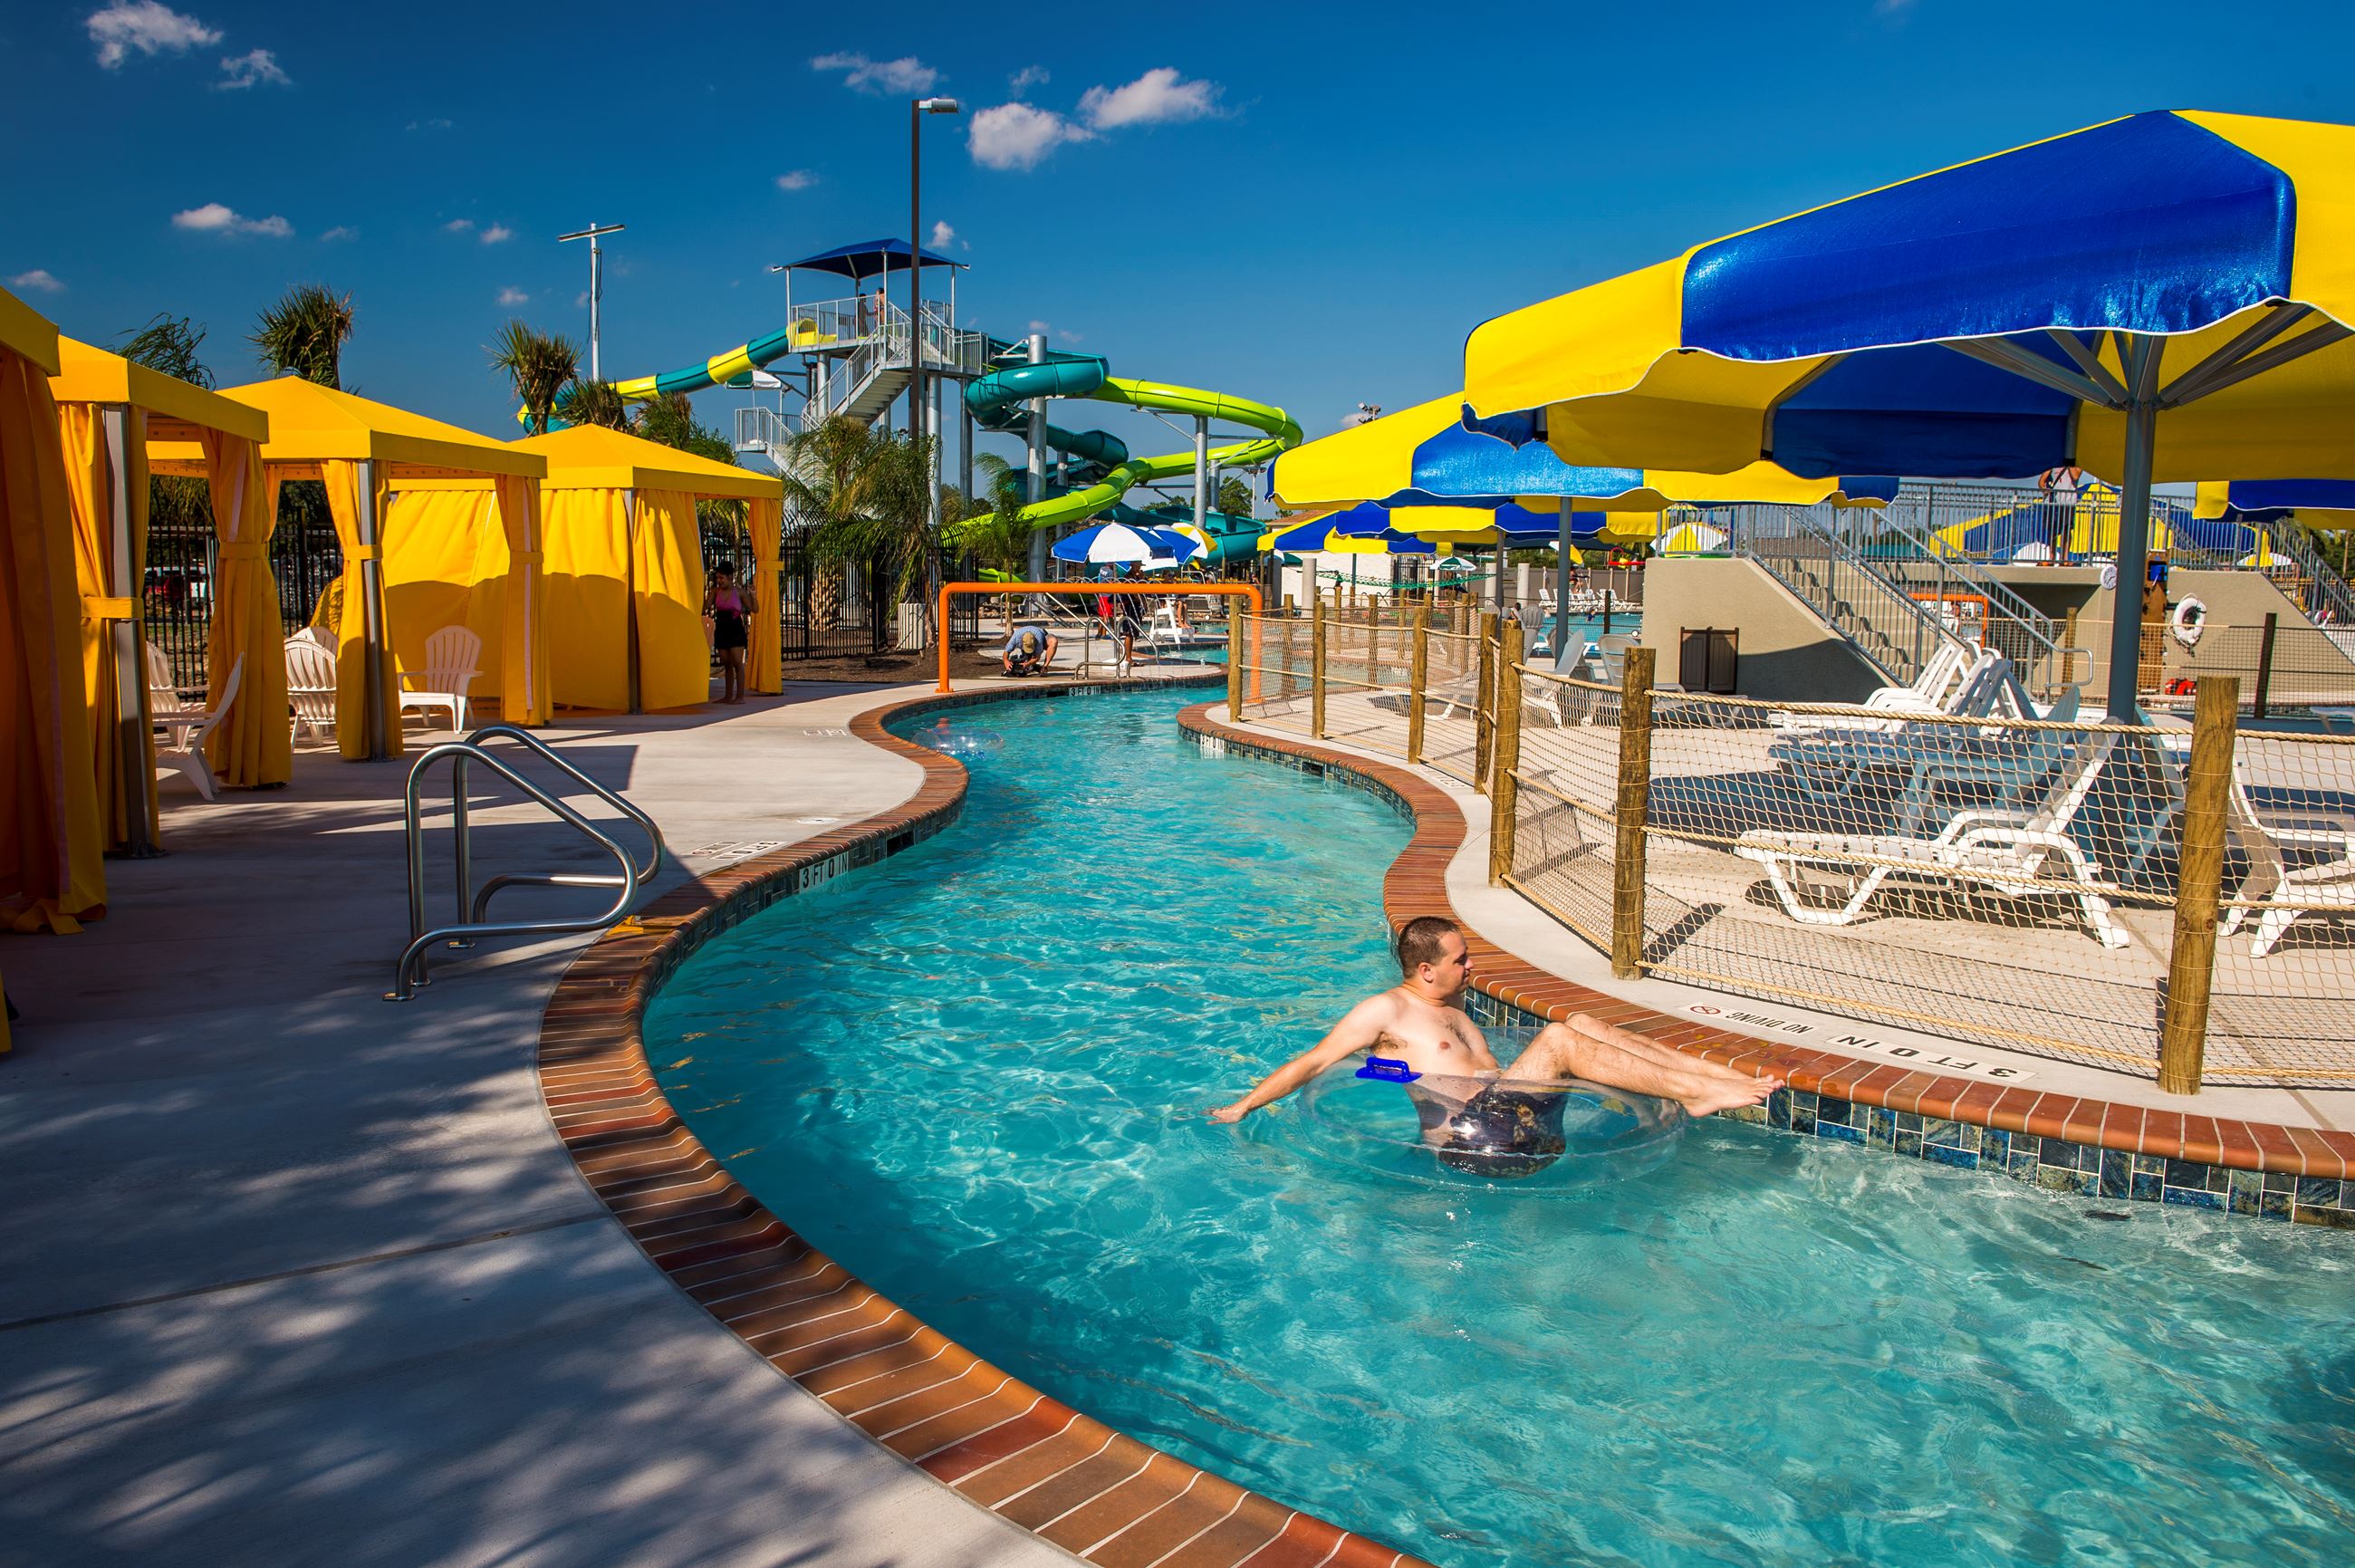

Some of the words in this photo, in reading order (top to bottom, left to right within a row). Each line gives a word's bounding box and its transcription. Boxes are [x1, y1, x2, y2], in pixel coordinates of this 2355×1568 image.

[1071, 688, 1076, 697] 3
[803, 868, 810, 889] 3
[812, 861, 824, 886] FT
[838, 851, 848, 876] IN
[1725, 1011, 1785, 1028] DIVING
[1783, 1024, 1813, 1034] NO
[1837, 1035, 1880, 1049] IN
[1927, 1056, 1978, 1070] FT
[1988, 1067, 2018, 1078] 3
